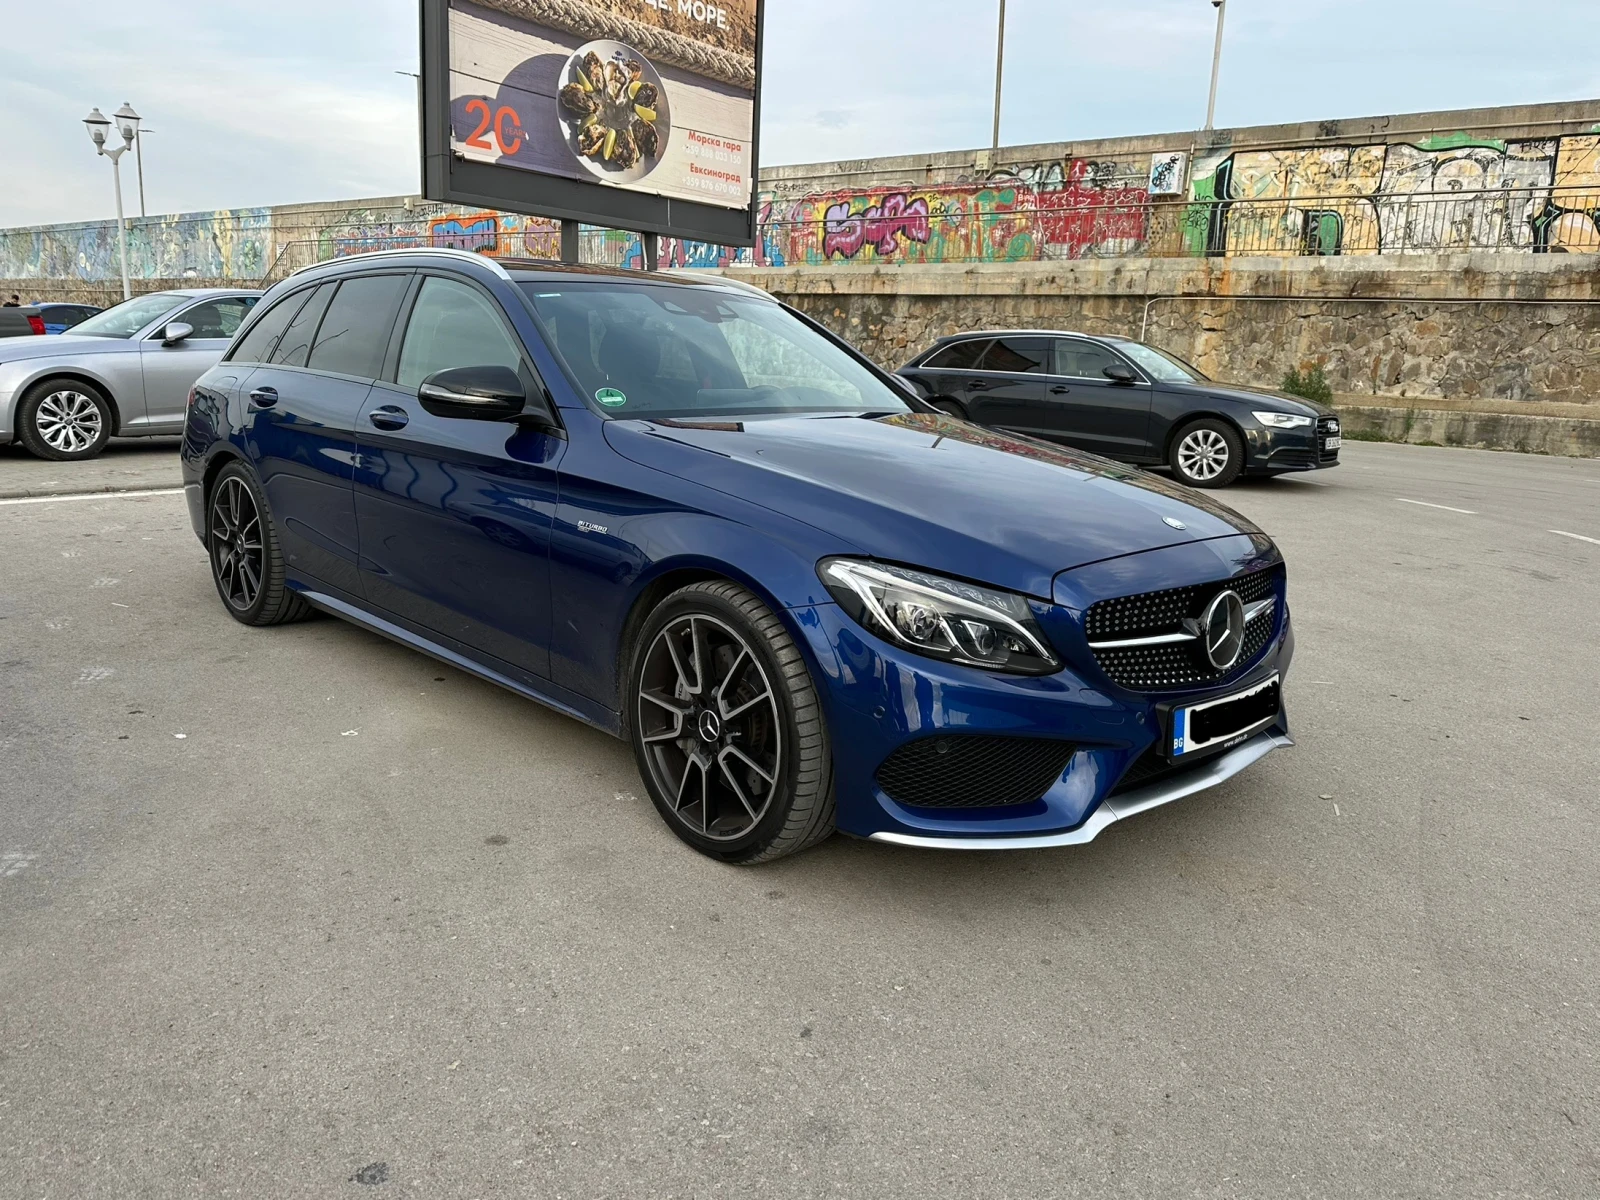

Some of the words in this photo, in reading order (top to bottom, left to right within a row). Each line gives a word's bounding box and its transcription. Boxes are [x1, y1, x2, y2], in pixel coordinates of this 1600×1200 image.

[677, 0, 730, 31] МОРЕ.
[465, 99, 522, 155] 20
[688, 130, 721, 147] Морска
[722, 141, 742, 153] гара
[690, 162, 741, 183] Евксиноград
[682, 176, 700, 187] +359
[700, 179, 714, 190] 876
[714, 181, 728, 193] 670
[1173, 737, 1184, 749] BG
